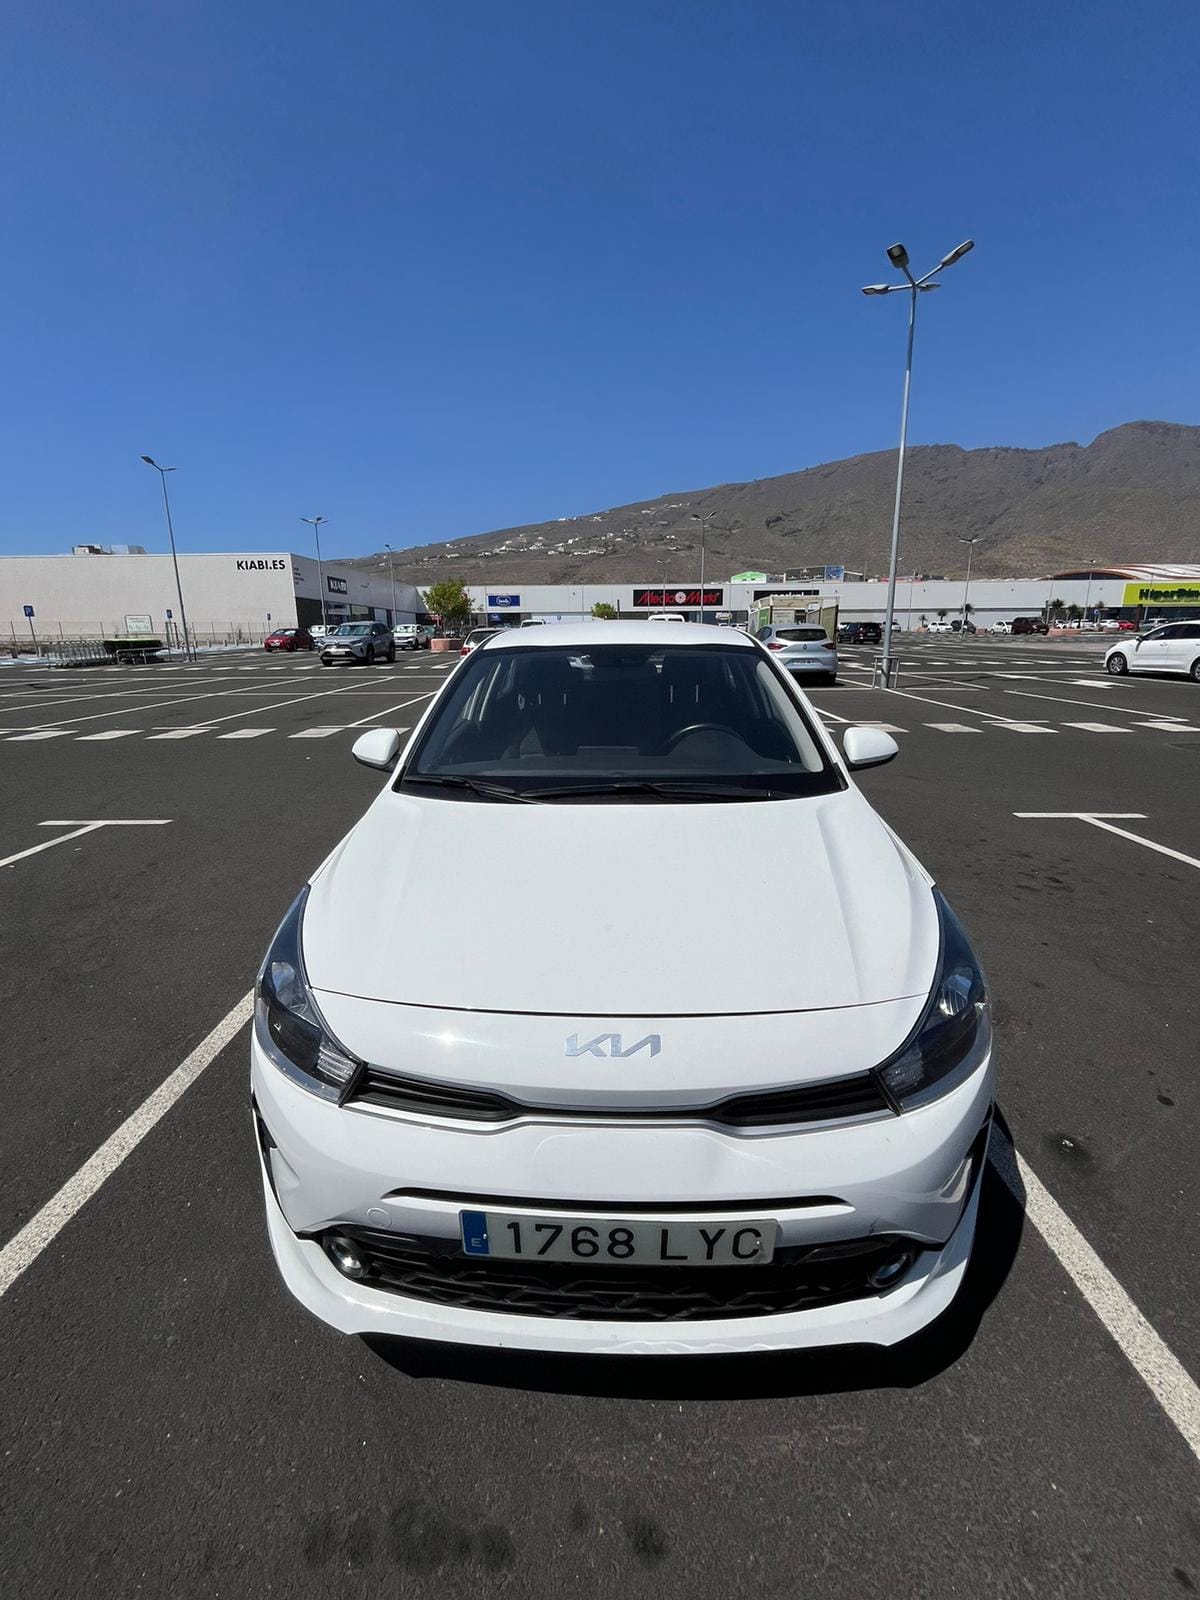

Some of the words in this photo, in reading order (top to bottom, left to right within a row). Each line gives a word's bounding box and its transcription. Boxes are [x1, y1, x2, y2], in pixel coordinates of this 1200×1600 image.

[236, 560, 286, 570] KIABI.ES
[565, 1032, 662, 1058] KIA
[471, 1236, 482, 1248] E
[506, 1221, 635, 1259] 1768
[660, 1228, 762, 1260] LYC
